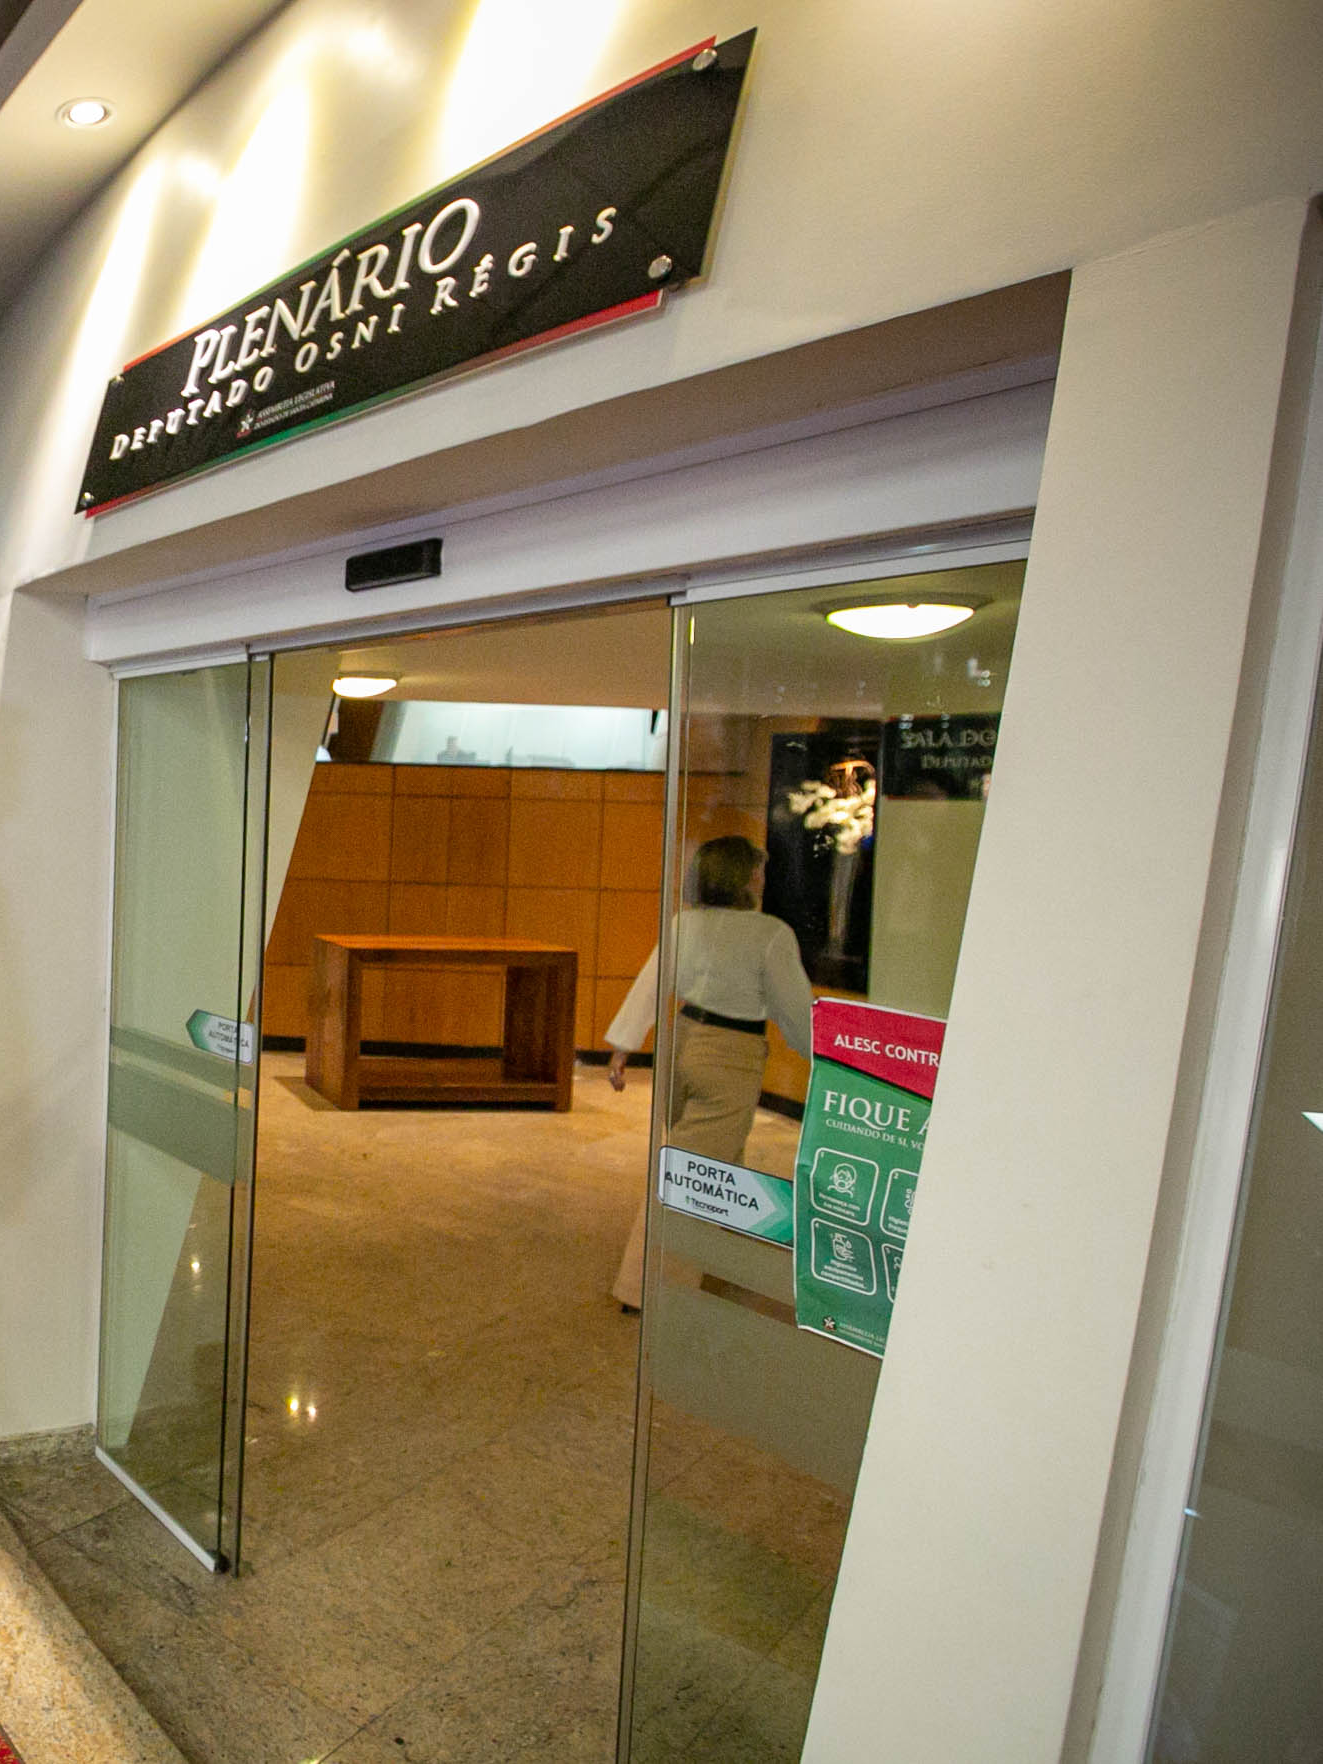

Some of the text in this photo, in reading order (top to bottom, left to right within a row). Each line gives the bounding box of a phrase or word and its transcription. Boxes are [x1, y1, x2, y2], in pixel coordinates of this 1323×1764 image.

[181, 197, 480, 398] PLENÁRIO
[109, 207, 617, 461] DEPUTADO OSNI RÉGIS
[900, 729, 954, 749] SALA
[834, 1034, 939, 1067] ALESC CONTR
[823, 1090, 912, 1132] FIQUE
[825, 1118, 881, 1139] CUIDANDO
[882, 1132, 896, 1144] DE
[664, 1171, 760, 1211] AUTOMÁTICA
[687, 1161, 736, 1186] PORTA
